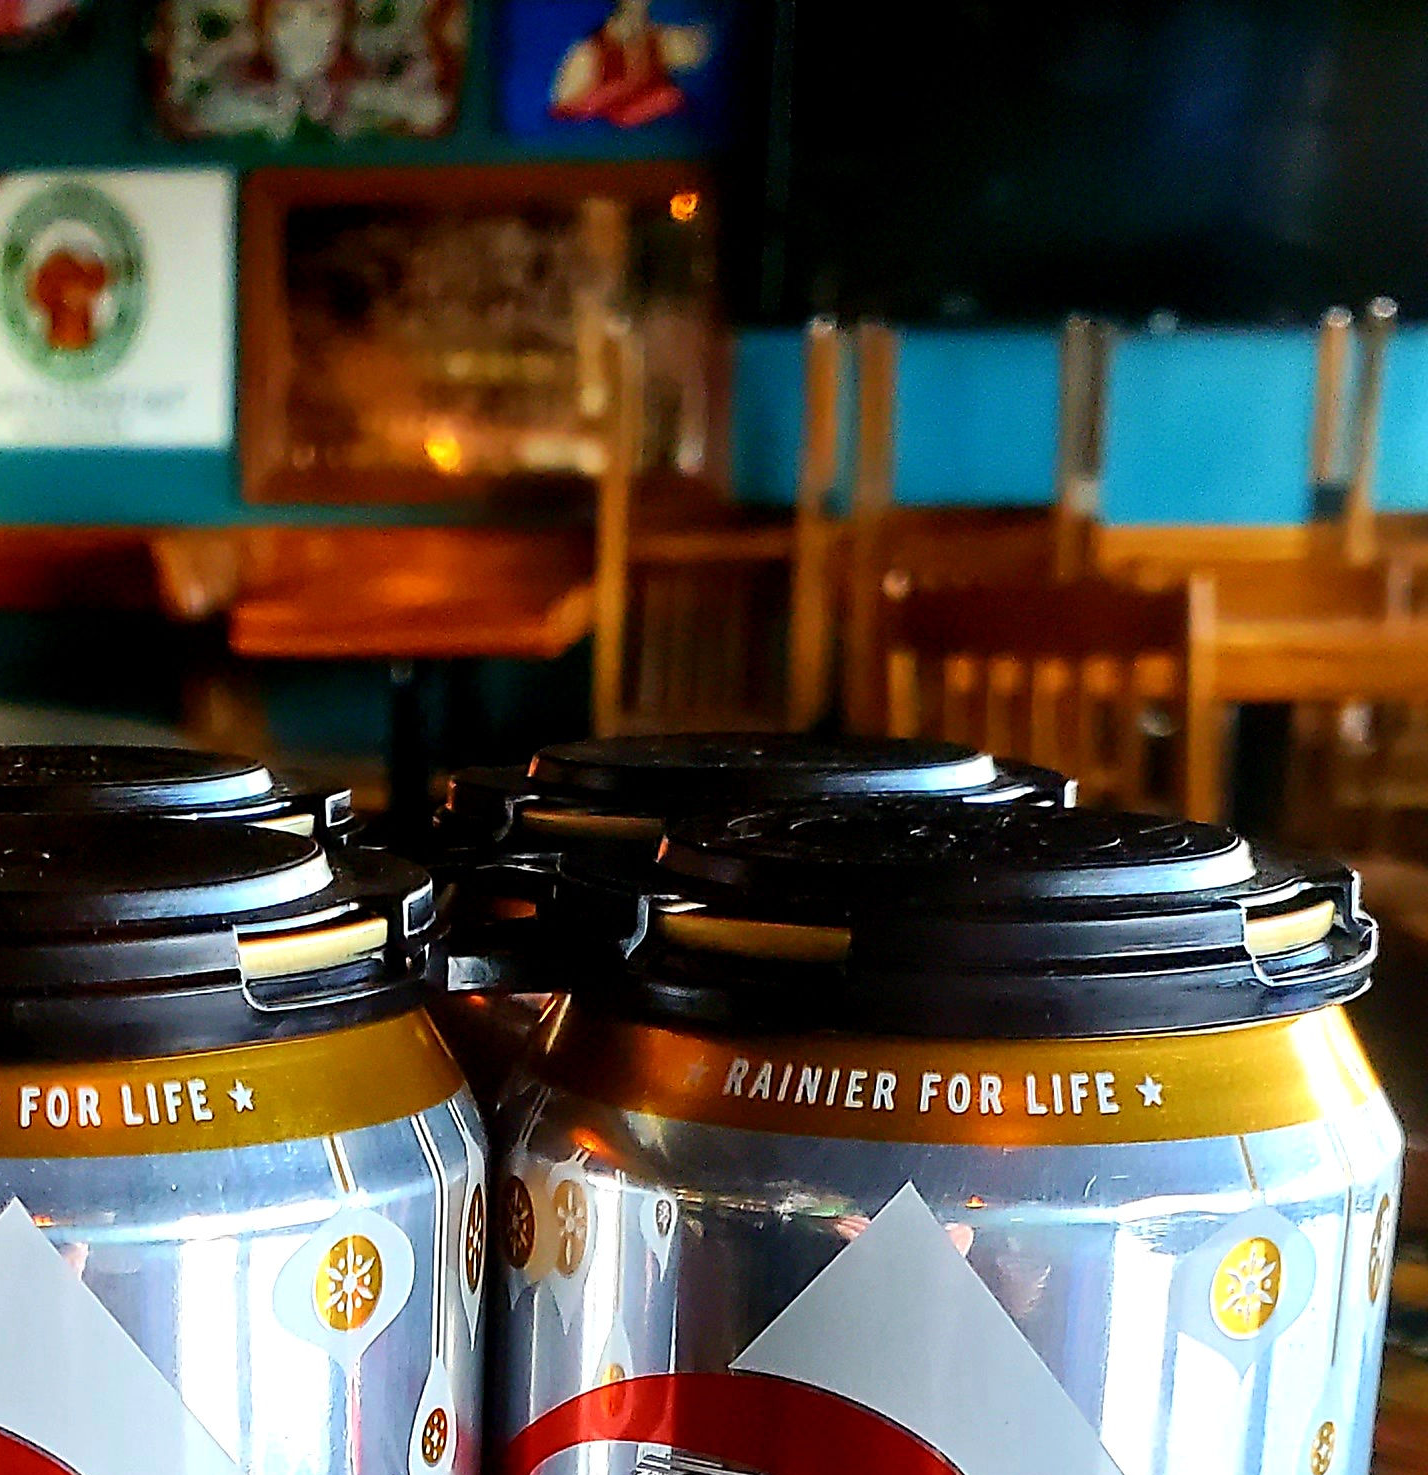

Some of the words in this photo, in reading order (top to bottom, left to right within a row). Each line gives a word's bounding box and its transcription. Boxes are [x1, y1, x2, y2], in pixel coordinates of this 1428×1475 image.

[19, 1083, 102, 1129] FOR
[122, 1078, 214, 1126] LIFE
[722, 1056, 898, 1111] RAINIER
[919, 1072, 1004, 1115] FOR
[1026, 1071, 1121, 1116] LIFE
